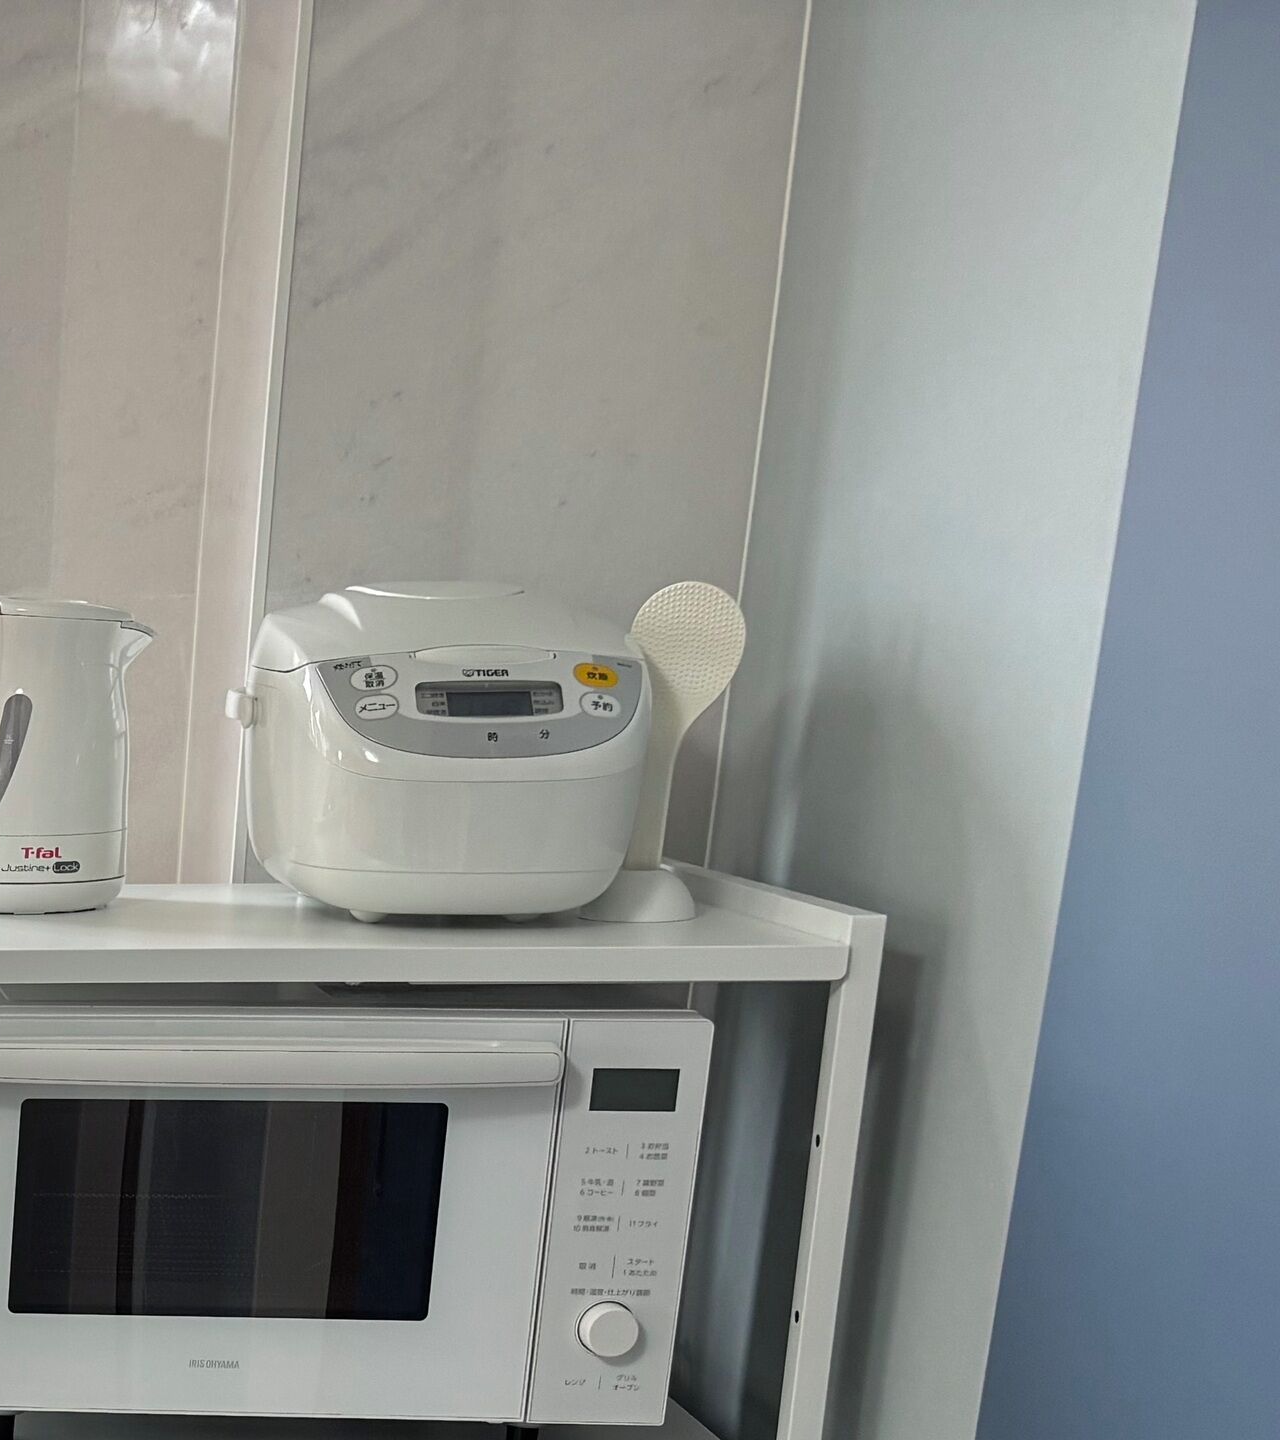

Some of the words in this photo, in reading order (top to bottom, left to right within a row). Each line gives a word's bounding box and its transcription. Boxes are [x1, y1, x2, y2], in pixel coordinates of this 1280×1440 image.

[474, 669, 509, 677] TIGER
[358, 702, 396, 713] メニュー
[590, 700, 613, 712] 予約
[539, 728, 550, 739] 分
[53, 861, 79, 872] Lock
[592, 1147, 619, 1155] トースト
[638, 1220, 658, 1228] フライ
[627, 1258, 655, 1266] スタート
[188, 1359, 205, 1369] IRIS
[205, 1359, 240, 1369] OHYAMA
